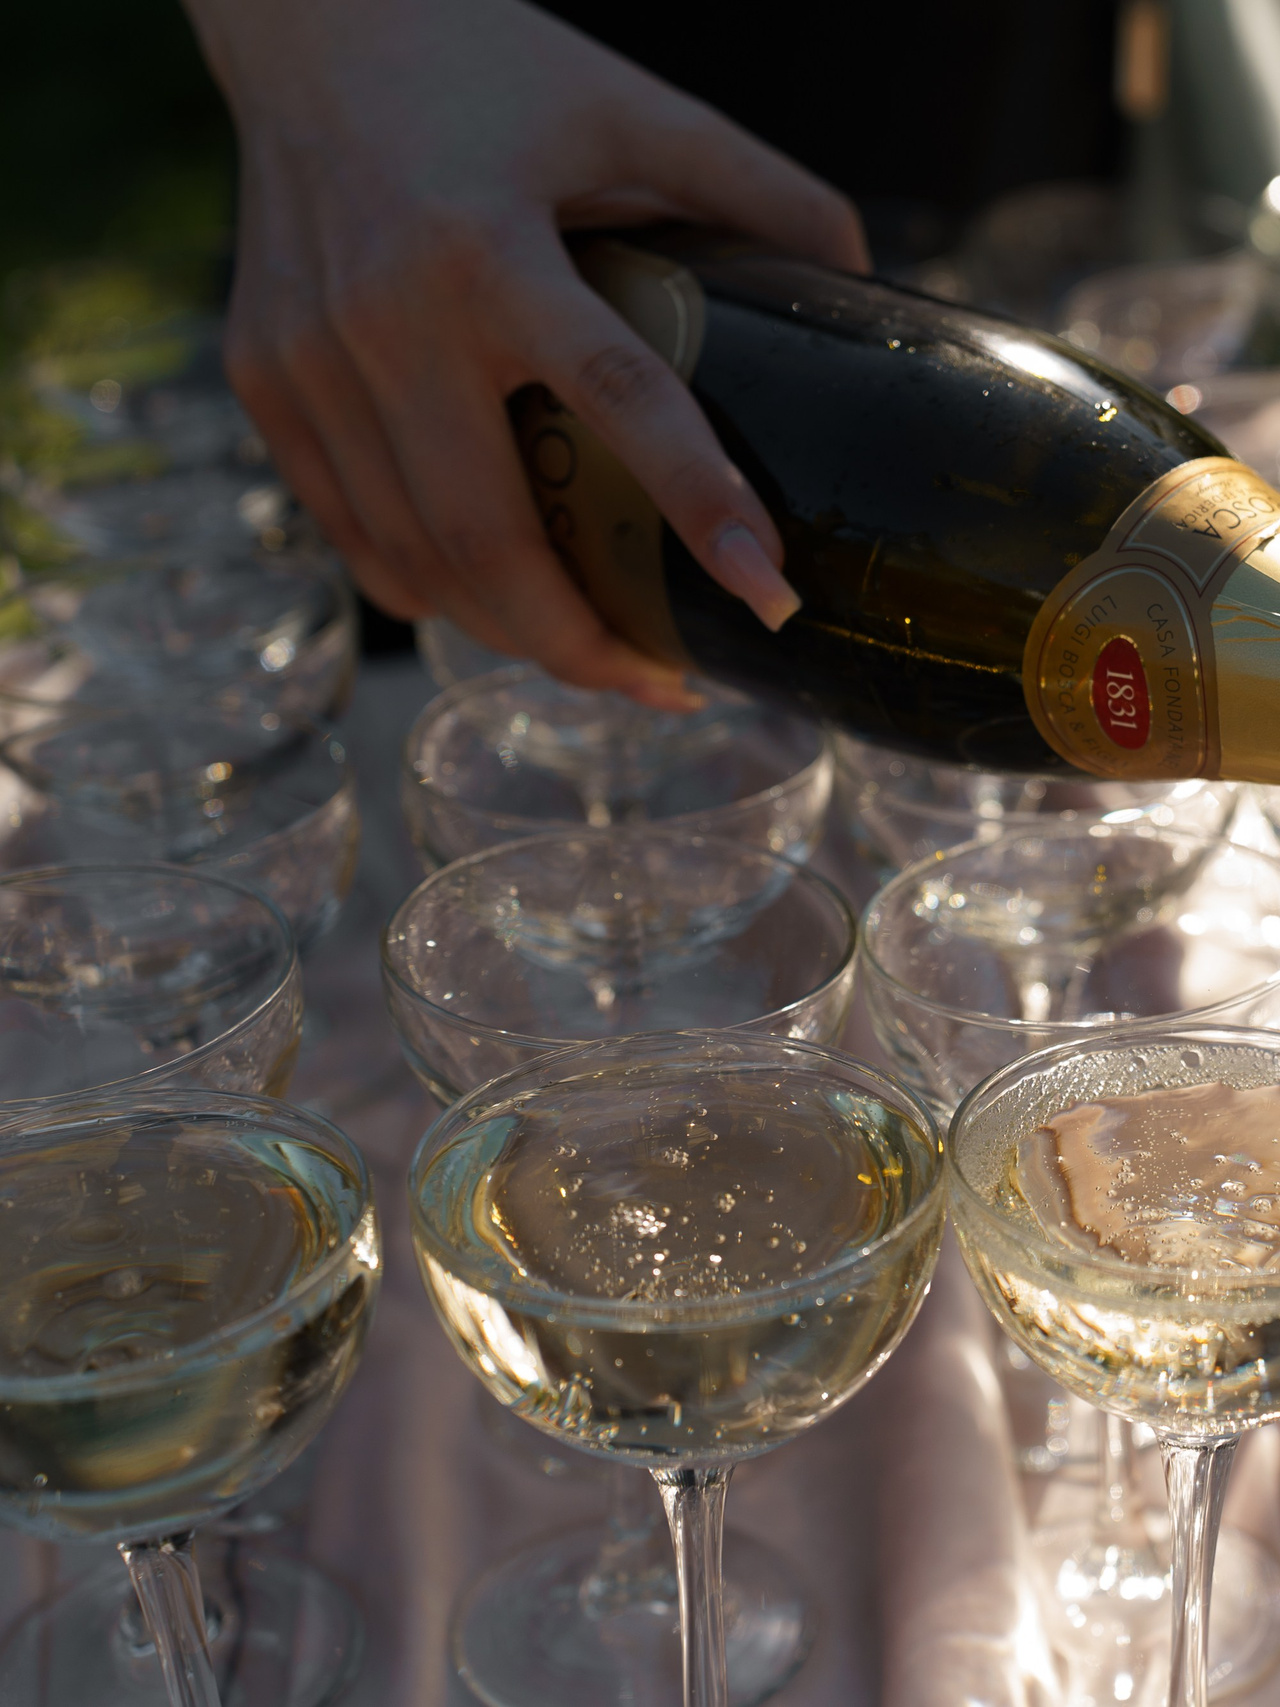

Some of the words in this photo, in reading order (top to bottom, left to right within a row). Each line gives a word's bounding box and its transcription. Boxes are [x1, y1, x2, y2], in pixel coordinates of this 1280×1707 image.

[1070, 594, 1118, 646] LUIGI
[1058, 649, 1080, 714] BOSCA
[1106, 668, 1138, 731] 1831
[1146, 602, 1177, 658] CASA
[1162, 666, 1184, 750] FONDATA
